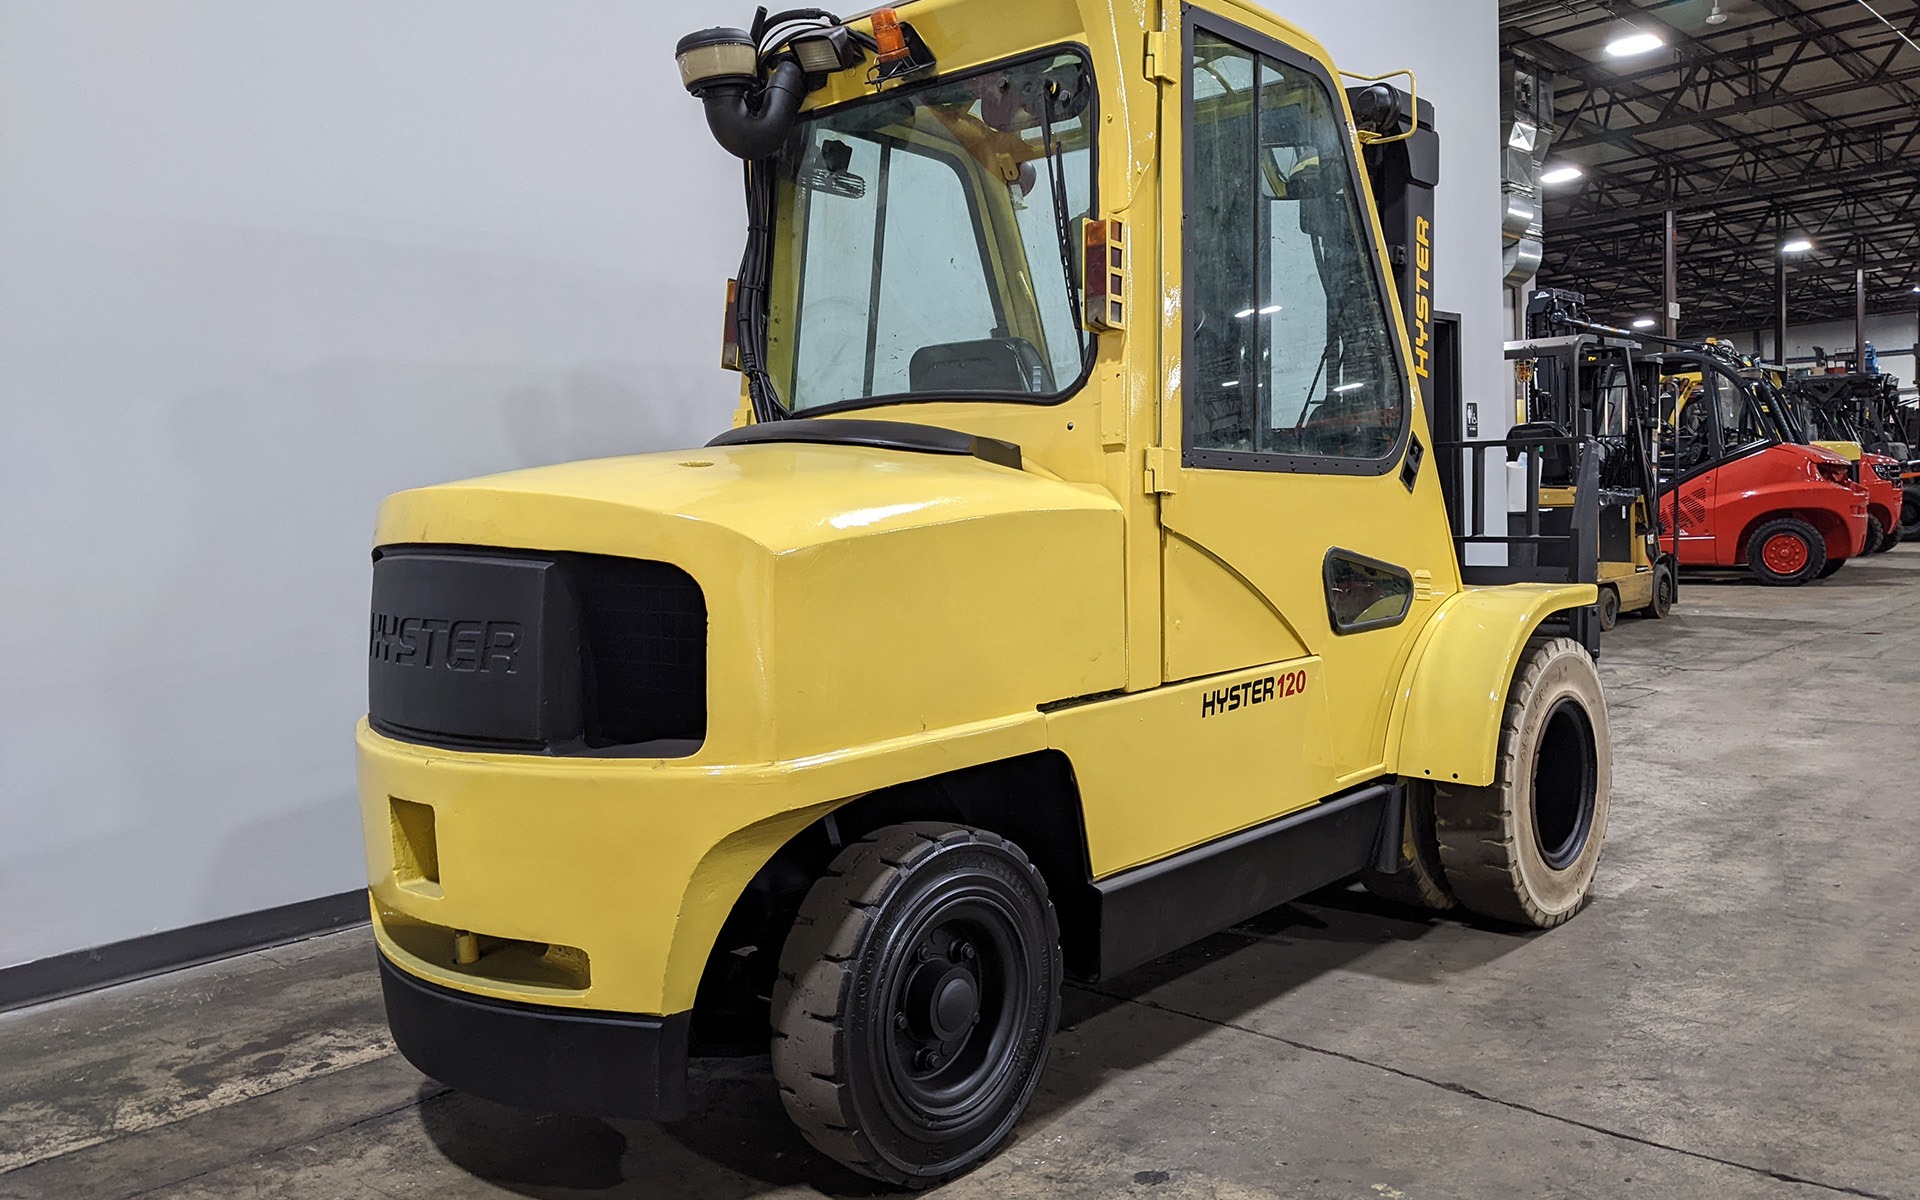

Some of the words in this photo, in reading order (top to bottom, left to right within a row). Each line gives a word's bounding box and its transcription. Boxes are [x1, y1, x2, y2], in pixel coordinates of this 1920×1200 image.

[1415, 215, 1430, 378] HYSTER
[369, 612, 524, 674] HYSTER
[1202, 676, 1275, 718] HYSTER
[1277, 669, 1306, 698] 120
